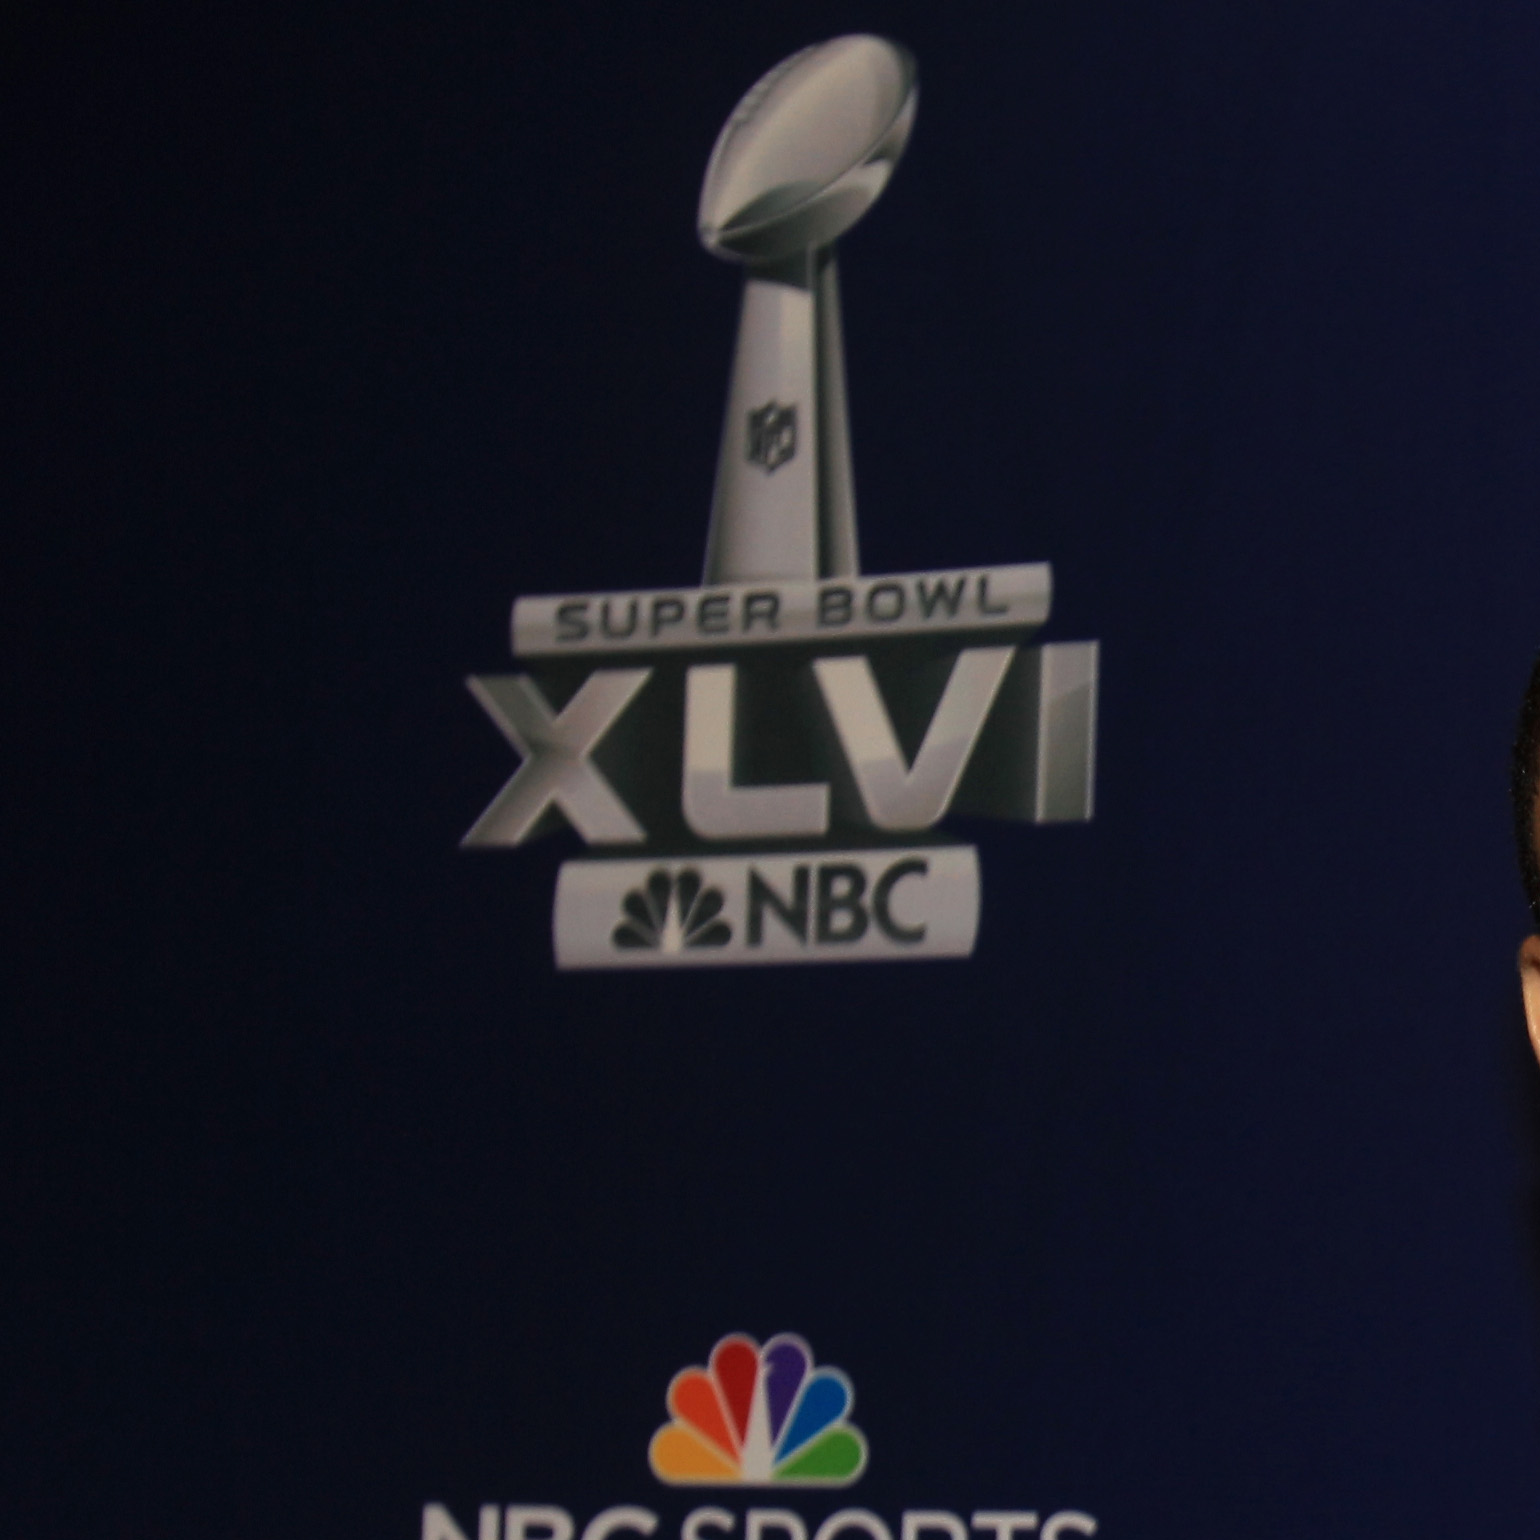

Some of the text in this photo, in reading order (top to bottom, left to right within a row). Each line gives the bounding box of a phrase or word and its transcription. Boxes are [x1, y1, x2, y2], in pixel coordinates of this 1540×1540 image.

[554, 575, 1011, 643] SUPER BOWL
[460, 640, 1100, 848] XLVI
[745, 858, 928, 948] NBC
